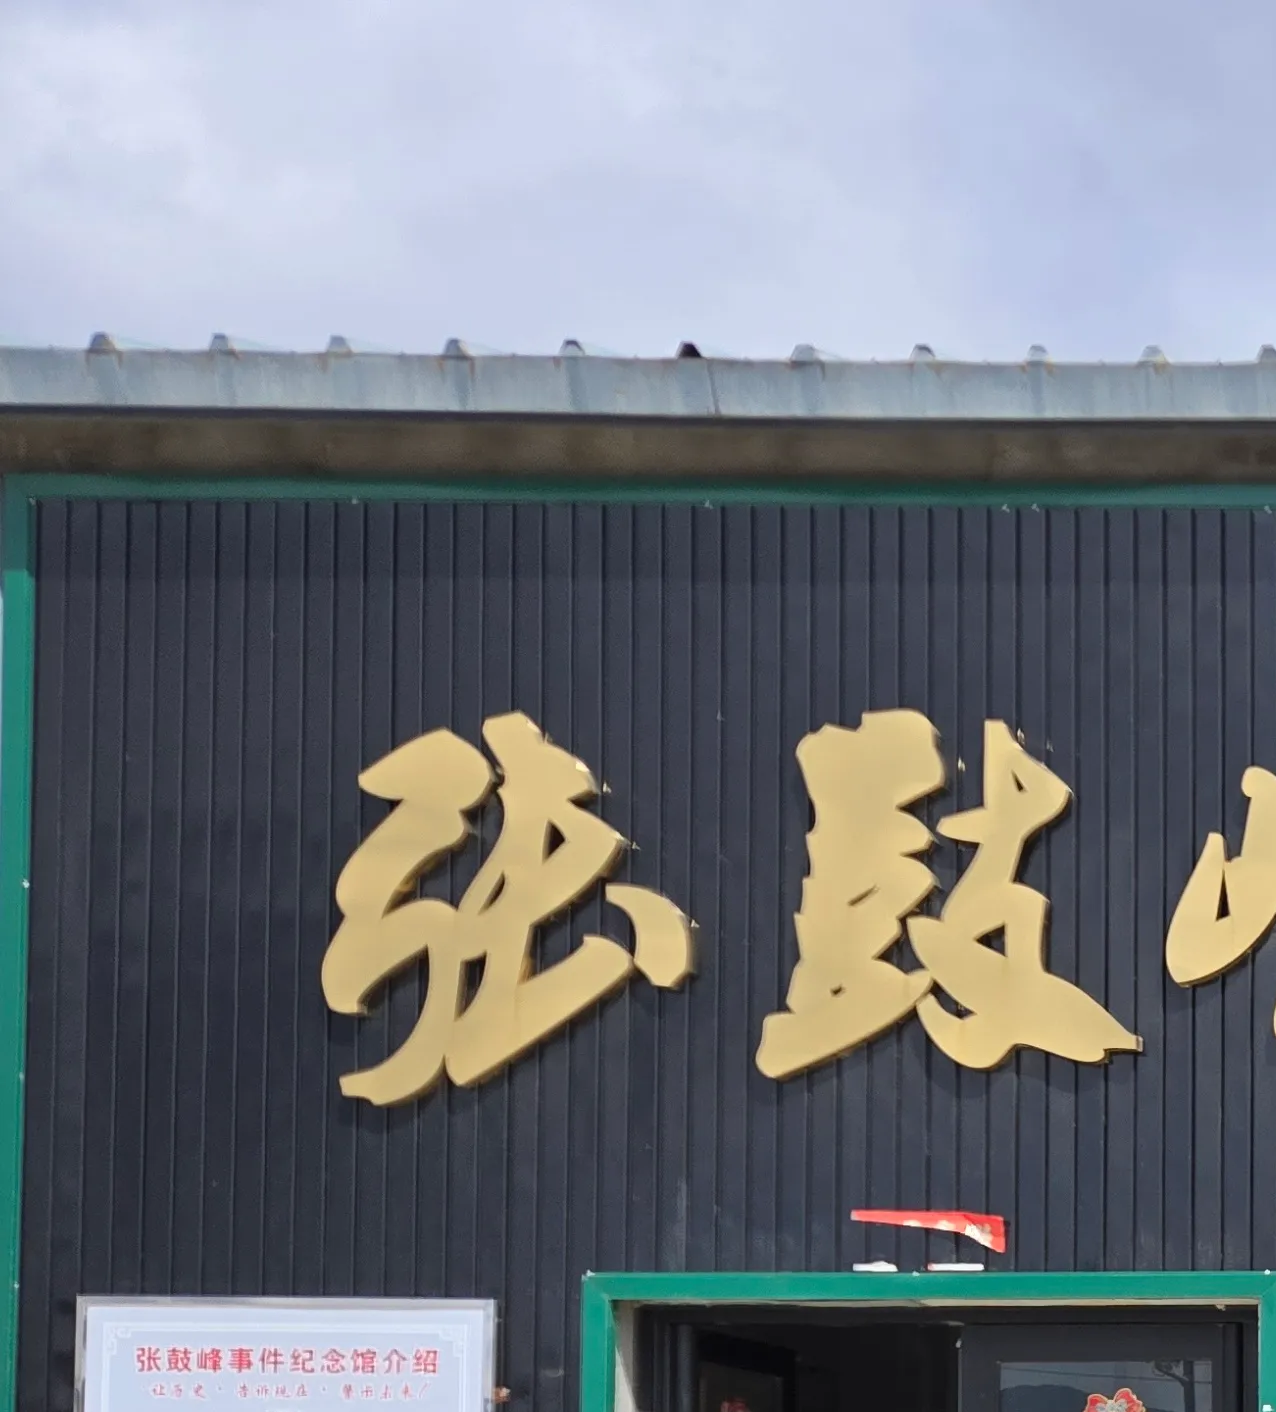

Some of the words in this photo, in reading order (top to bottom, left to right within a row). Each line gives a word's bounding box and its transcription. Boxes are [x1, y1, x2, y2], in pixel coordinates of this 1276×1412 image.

[136, 1346, 438, 1375] 张鼓峰事件纪念馆介绍
